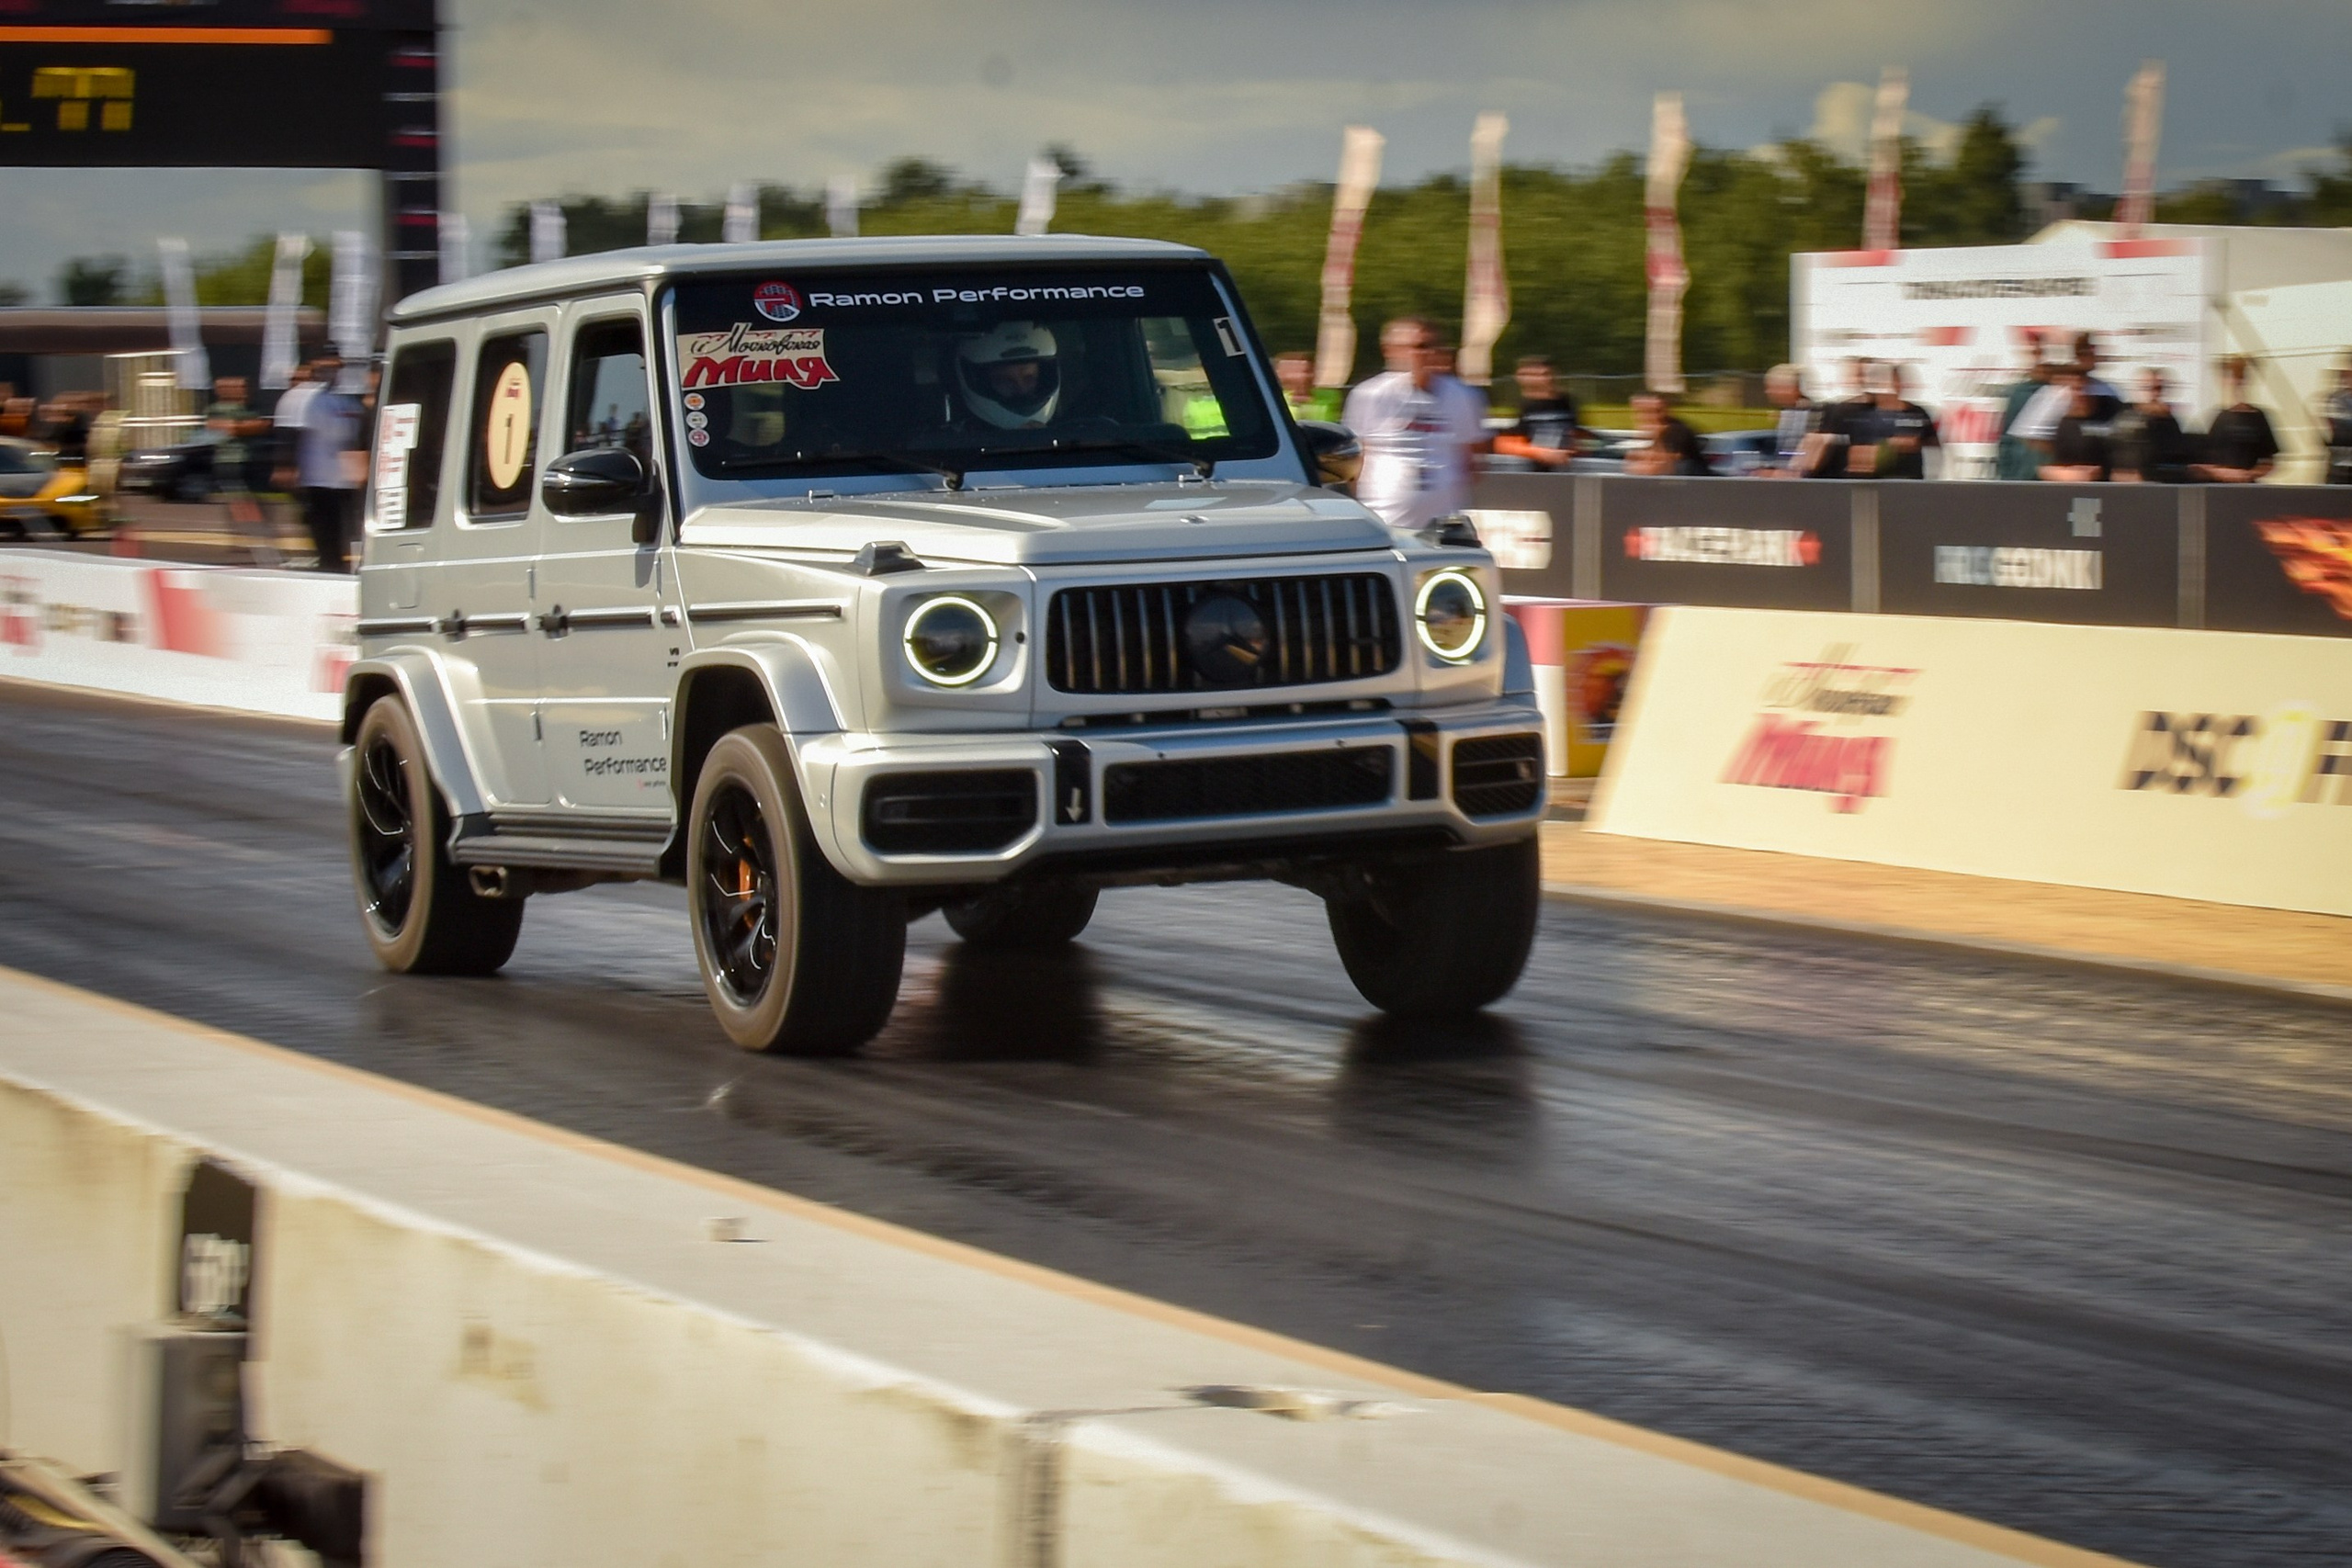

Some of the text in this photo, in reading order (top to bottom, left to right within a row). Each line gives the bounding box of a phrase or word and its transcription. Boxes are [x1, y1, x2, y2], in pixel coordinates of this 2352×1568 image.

[808, 285, 1145, 308] Ramon Performance
[691, 322, 821, 355] Московская
[1217, 319, 1241, 353] 1
[683, 355, 837, 388] Миля
[579, 730, 623, 747] Ramon
[584, 757, 667, 775] Performance
